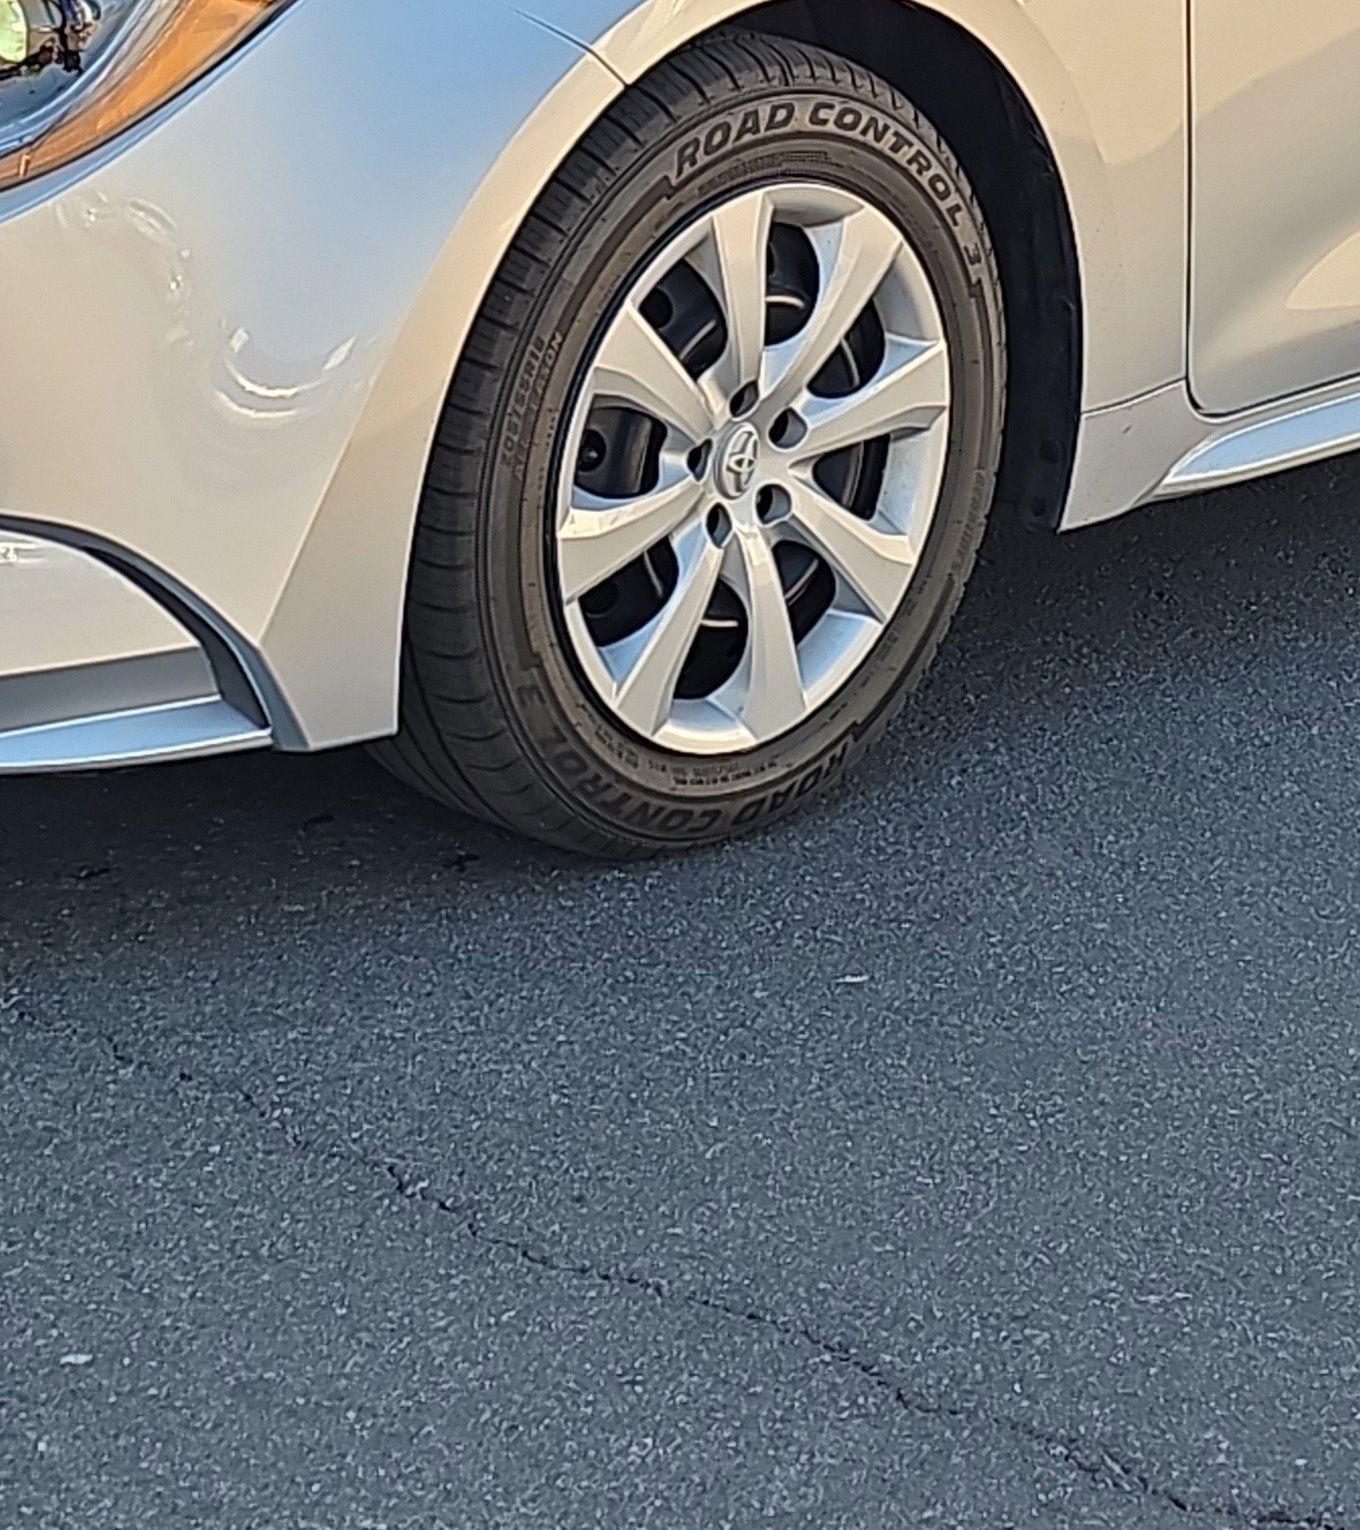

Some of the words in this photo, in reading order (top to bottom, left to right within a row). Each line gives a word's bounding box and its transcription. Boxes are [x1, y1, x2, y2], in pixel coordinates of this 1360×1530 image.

[673, 101, 796, 179] ROAD
[808, 101, 963, 228] CONTROL
[540, 724, 724, 834] CONTROL
[730, 739, 851, 828] ROAD
